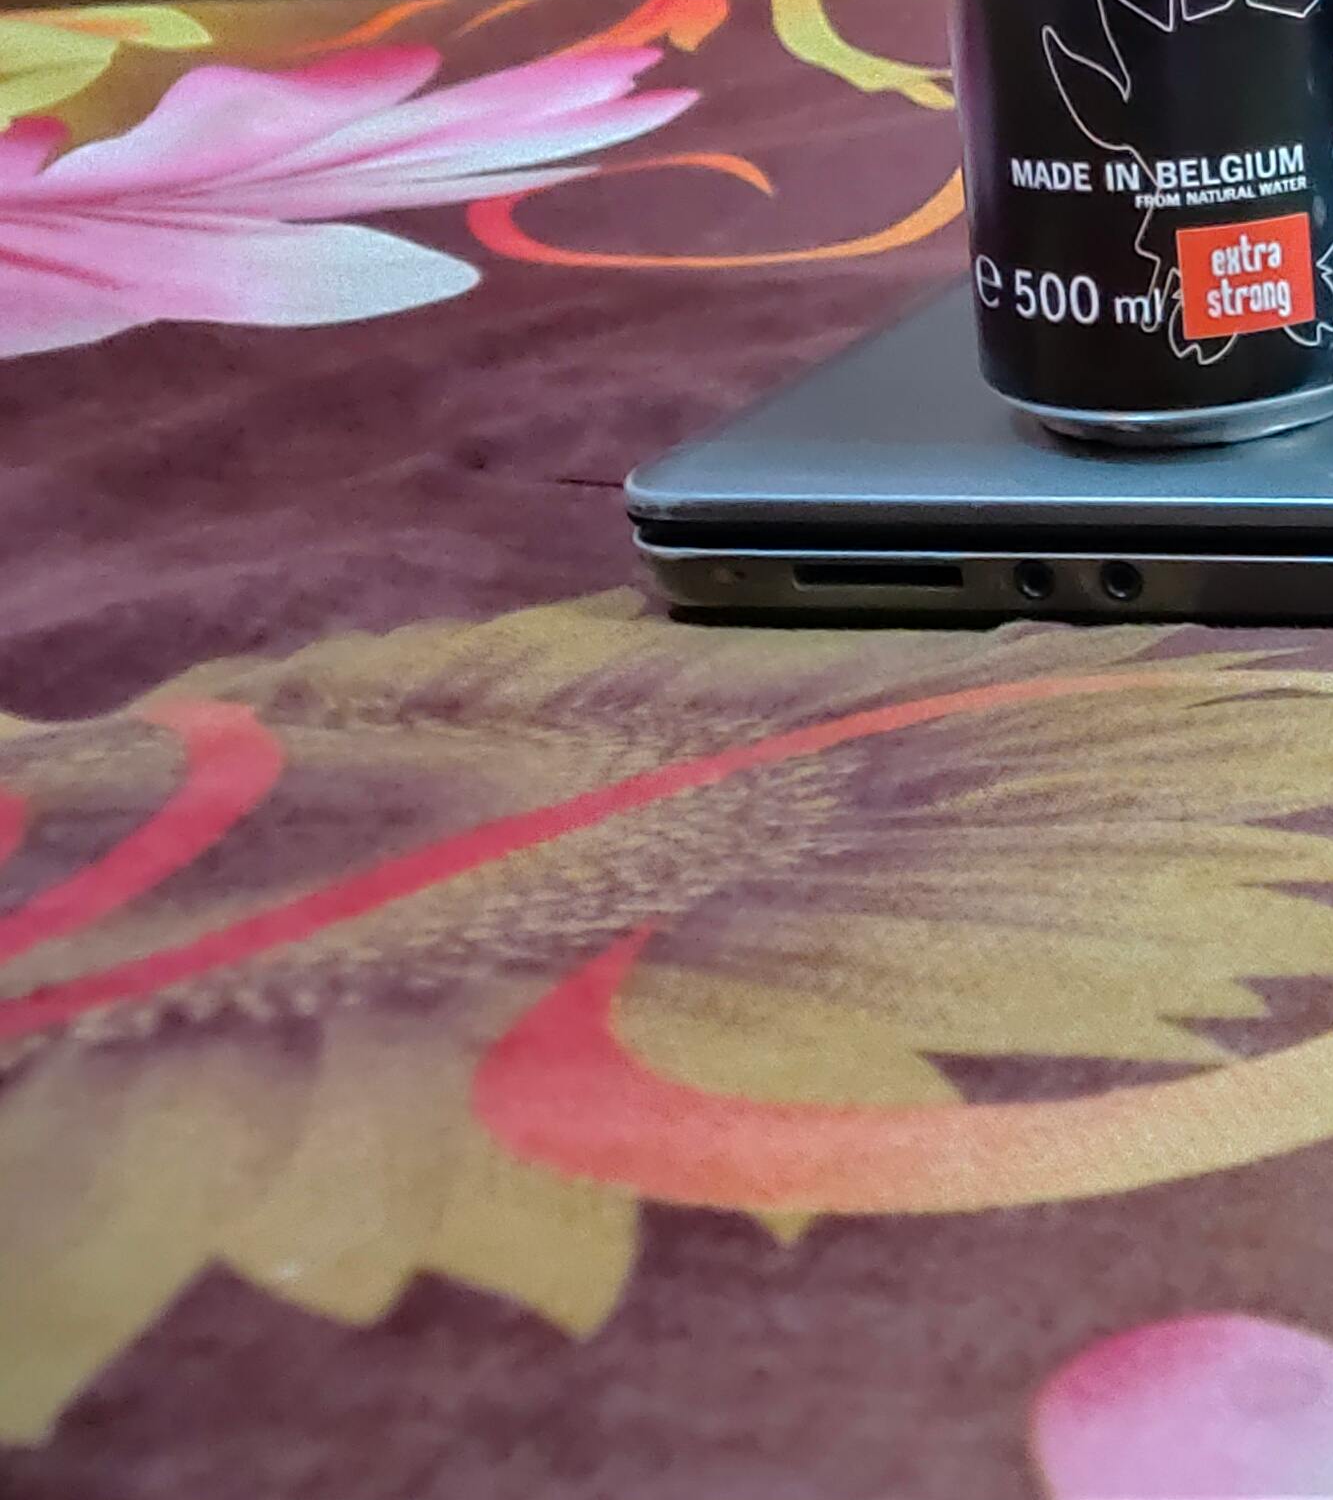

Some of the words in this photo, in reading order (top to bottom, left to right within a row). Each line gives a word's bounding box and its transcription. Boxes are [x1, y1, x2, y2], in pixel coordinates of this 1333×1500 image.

[1011, 159, 1092, 191] MADE
[1105, 160, 1141, 191] IN
[1158, 144, 1305, 190] BELGIUM
[1135, 192, 1179, 210] FROM
[1185, 185, 1256, 205] NATURAL
[1258, 176, 1307, 197] WATER
[1211, 234, 1282, 277] extra
[1014, 269, 1099, 324] 500
[1114, 289, 1164, 325] ml
[1206, 278, 1292, 319] strong
